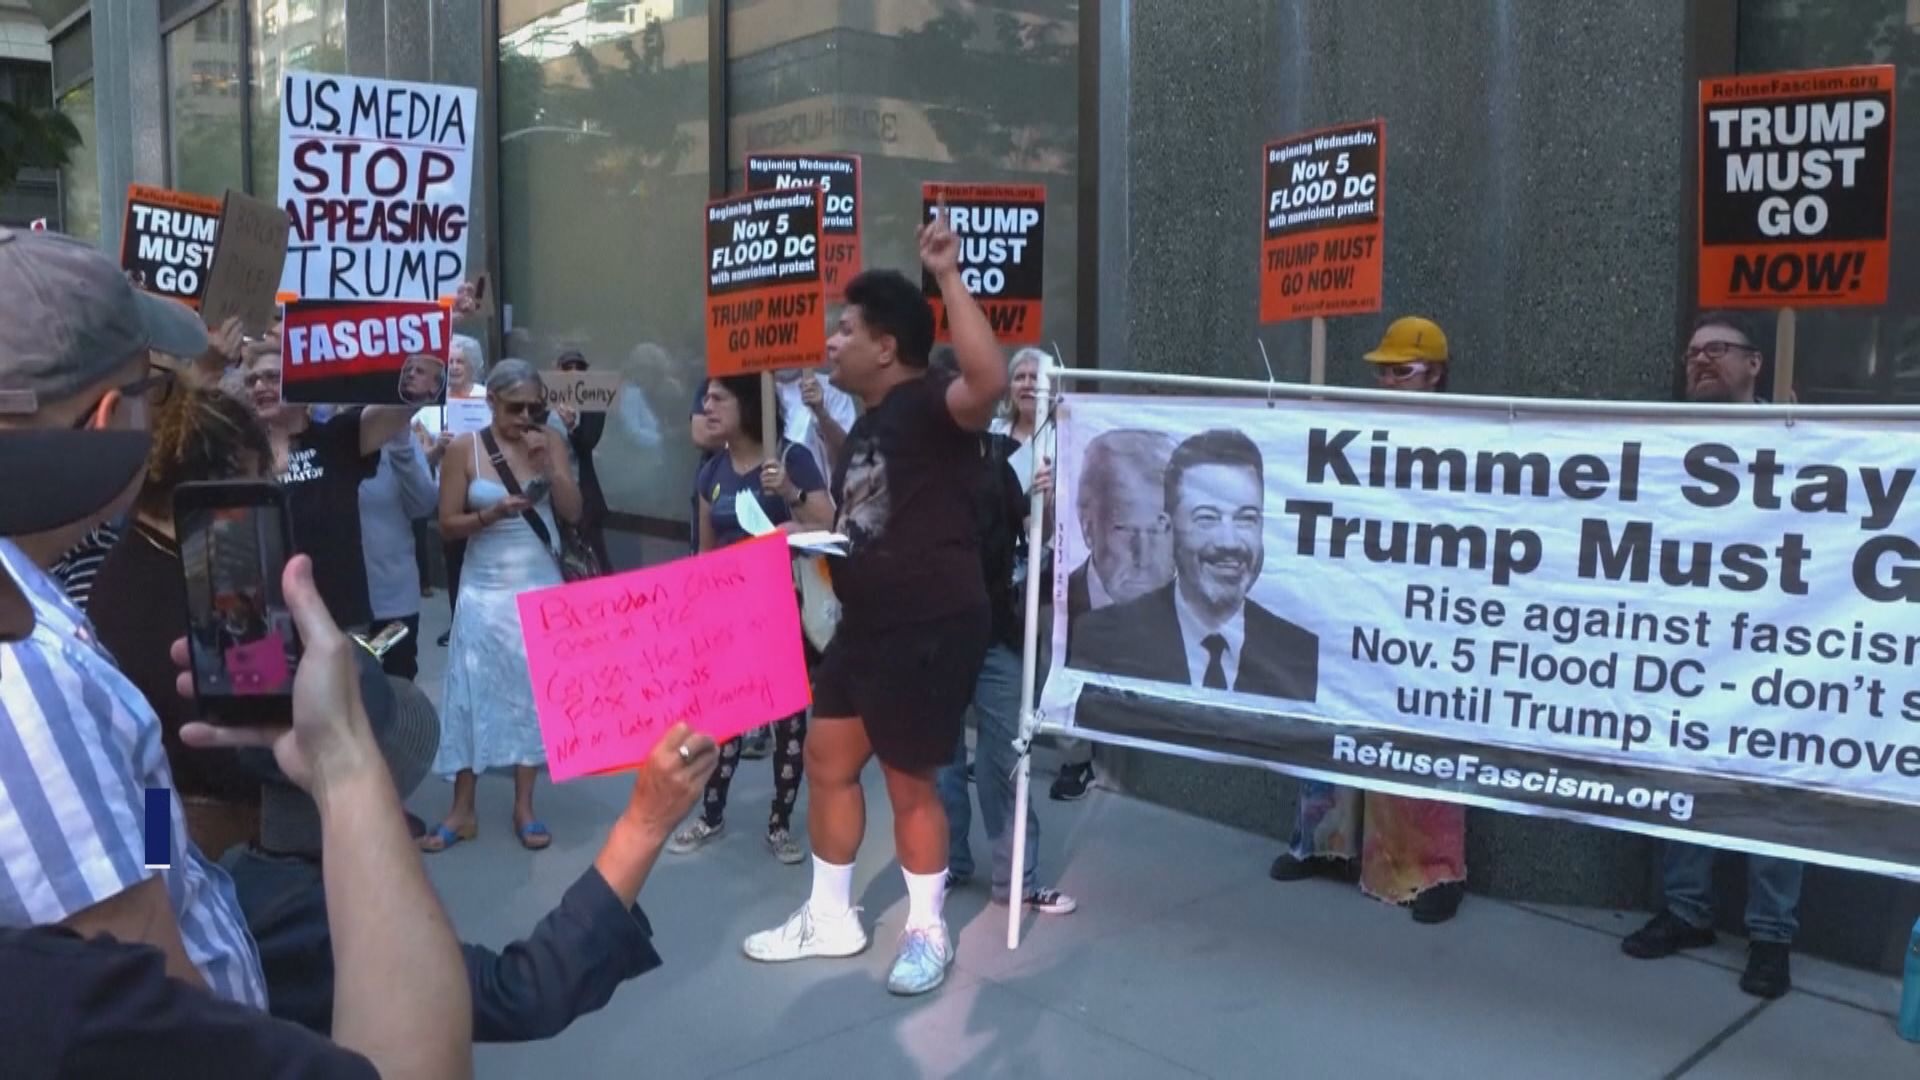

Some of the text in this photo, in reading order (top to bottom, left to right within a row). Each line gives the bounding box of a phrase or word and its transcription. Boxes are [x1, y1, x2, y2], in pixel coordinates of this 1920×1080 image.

[1712, 75, 1879, 97] RefuseFascism.org
[286, 76, 466, 145] U.S. MEDIA
[1709, 100, 1885, 148] TRUMP
[1269, 131, 1376, 163] Beginning Wednesday,
[293, 140, 455, 200] STOP
[750, 159, 853, 173] Beginning Wednesday,
[820, 175, 831, 192] 5
[1291, 152, 1350, 183] Nov 5
[1726, 148, 1866, 193] MUST
[709, 193, 814, 221] Beginning Wednesday,
[826, 196, 855, 213] DC
[1270, 173, 1376, 212] FLOOD DC
[132, 203, 220, 242] TRUM
[285, 199, 467, 244] APPEASING
[733, 213, 790, 242] Nov 5
[1268, 198, 1375, 229] with nonviolent protest
[1757, 195, 1829, 236] GO
[712, 234, 816, 269] FLOOD DC
[825, 245, 855, 261] UST
[1267, 235, 1377, 271] TRUMP MUST
[155, 266, 199, 295] GO
[287, 246, 462, 301] TRUMP
[711, 268, 730, 286] with
[731, 262, 777, 282] nonviolent
[778, 258, 815, 277] protest
[960, 267, 1005, 294] GO
[1281, 266, 1355, 297] GO NOW!
[1729, 251, 1867, 294] NOW!
[712, 293, 818, 327] TRUMP MUST
[288, 311, 445, 366] FASCIST
[729, 322, 799, 352] GO NOW!
[1306, 427, 1916, 531] Kimmel Stay
[1285, 499, 1543, 586] Trump
[1577, 517, 1812, 595] Must
[1405, 584, 1506, 628] Rise
[1523, 601, 1711, 648] against
[1352, 626, 1438, 669] Nov.
[1451, 637, 1476, 673] 5
[1491, 640, 1618, 689] Flood
[1634, 655, 1706, 698] DC
[1751, 668, 1886, 718] don't
[1397, 686, 1920, 778] until Trump is remove
[1332, 734, 1695, 820] RefuseFascism.org
